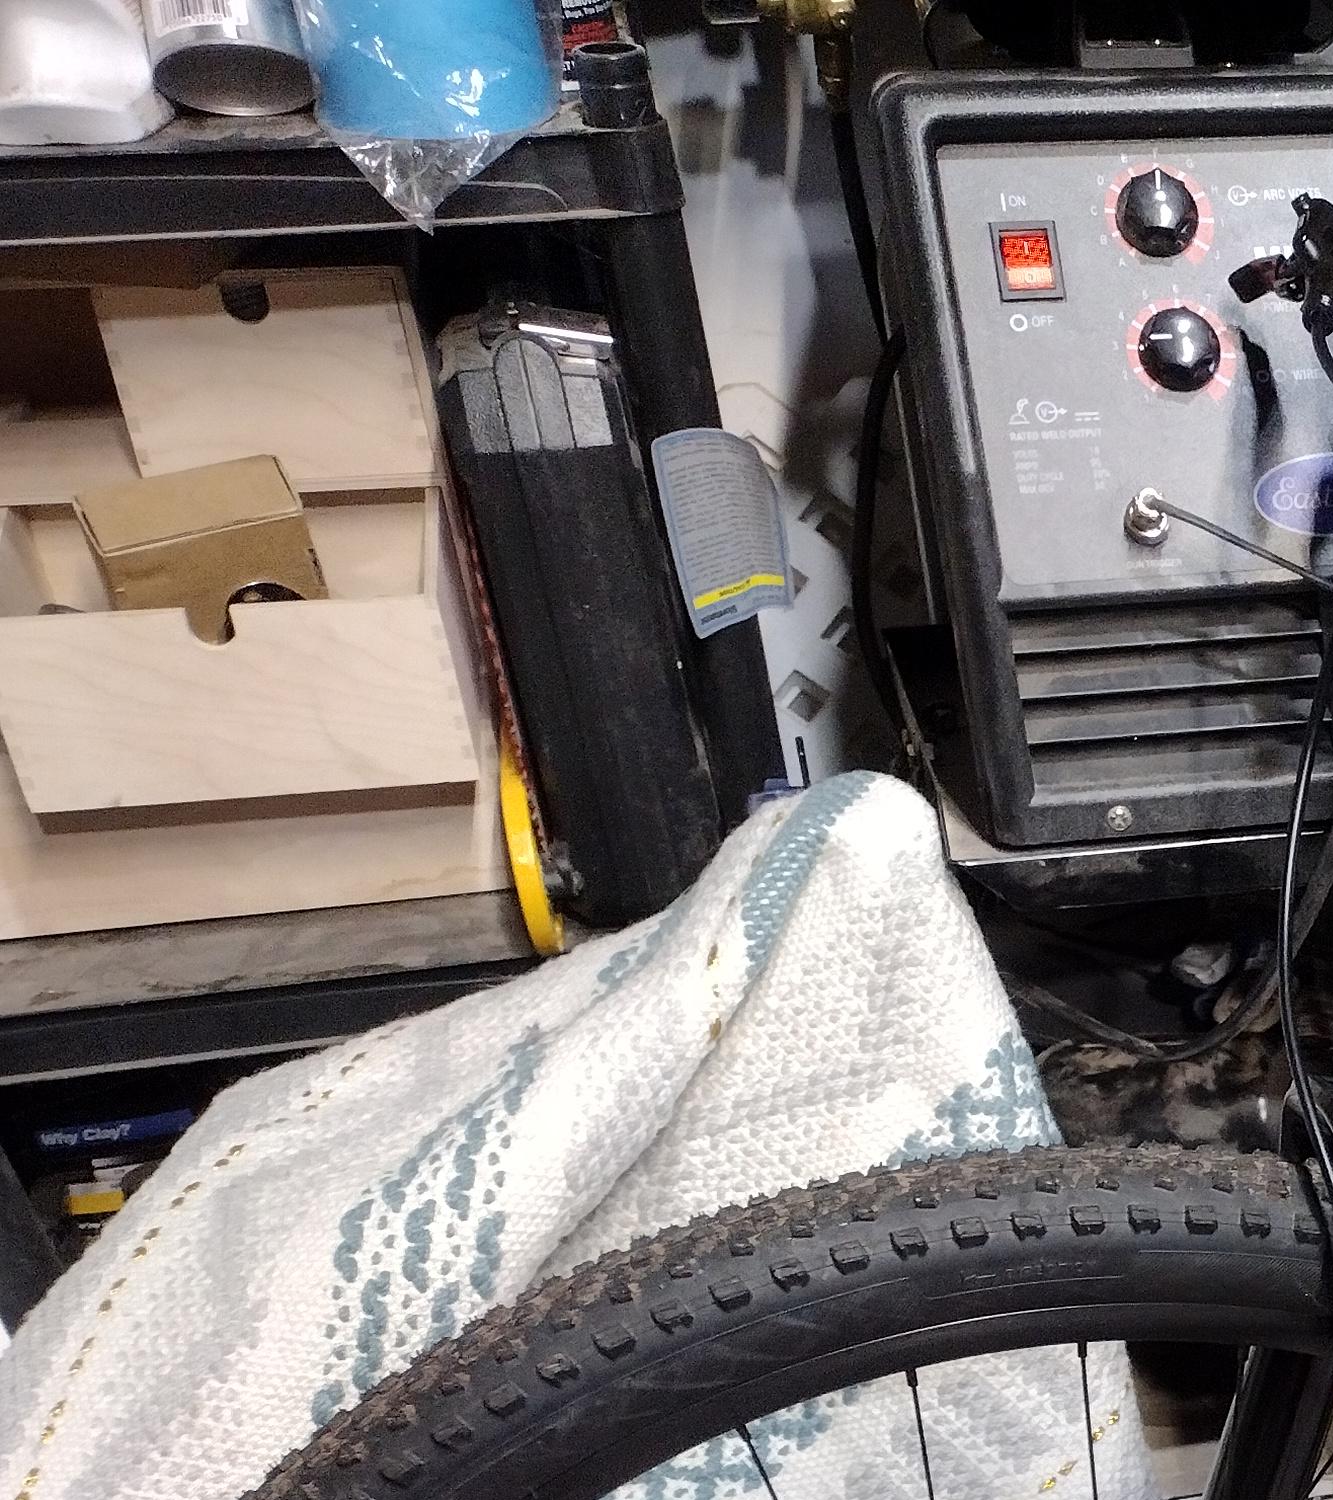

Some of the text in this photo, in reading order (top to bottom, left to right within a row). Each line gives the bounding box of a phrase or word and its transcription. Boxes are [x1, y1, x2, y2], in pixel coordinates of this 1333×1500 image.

[1263, 188, 1287, 201] ARC
[1288, 186, 1323, 201] VOTS
[1007, 194, 1027, 208] ON
[1031, 316, 1054, 329] OFF
